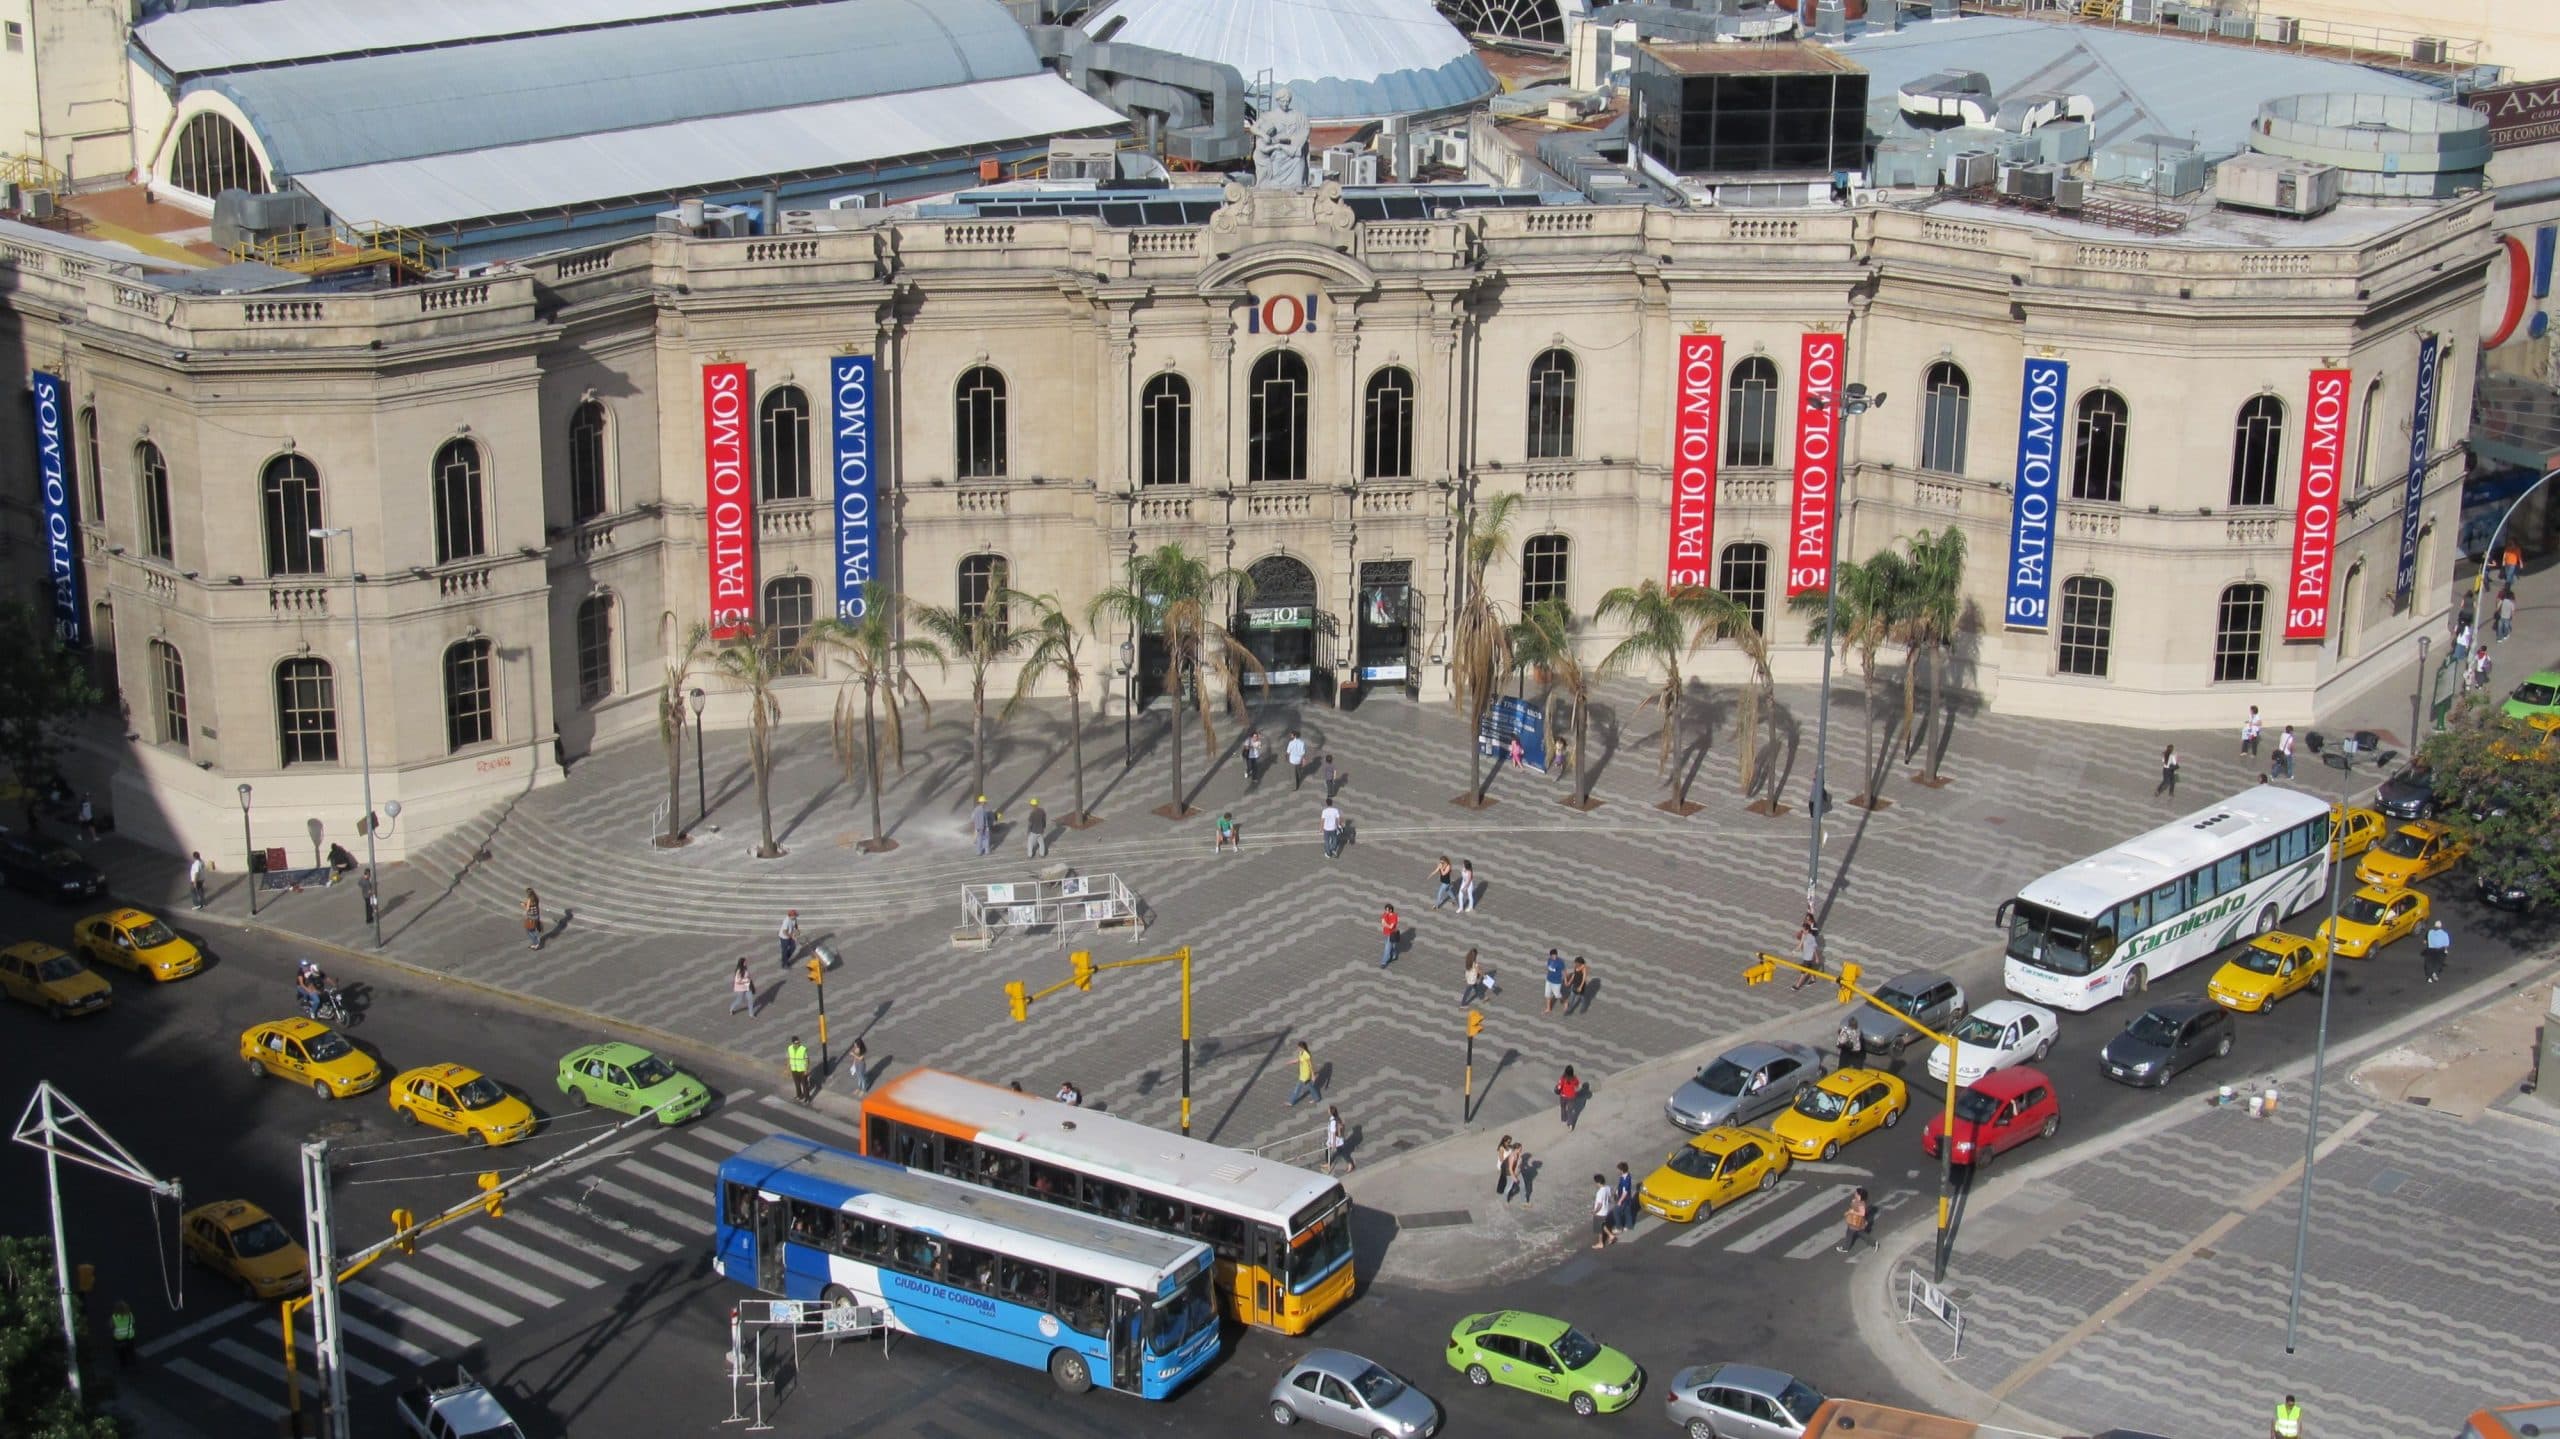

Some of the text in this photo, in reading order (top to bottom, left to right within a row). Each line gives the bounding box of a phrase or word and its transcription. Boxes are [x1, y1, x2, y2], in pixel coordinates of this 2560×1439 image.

[2499, 131, 2511, 143] DE
[39, 383, 75, 612] PATIO OLMOS
[711, 373, 744, 598] PATIO OLMOS
[839, 365, 869, 589] PATIO OLMOS
[1677, 344, 1713, 560] PATIO OLMOS
[1798, 466, 1828, 558] PATIO
[2017, 369, 2058, 589] PATIO OLMOS
[2297, 378, 2342, 600] PATIO OLMOS
[2403, 345, 2435, 560] PATIO OLMOS
[2121, 893, 2247, 961] Sarmiento
[894, 1276, 996, 1313] CIUDAD DE CORDOBA
